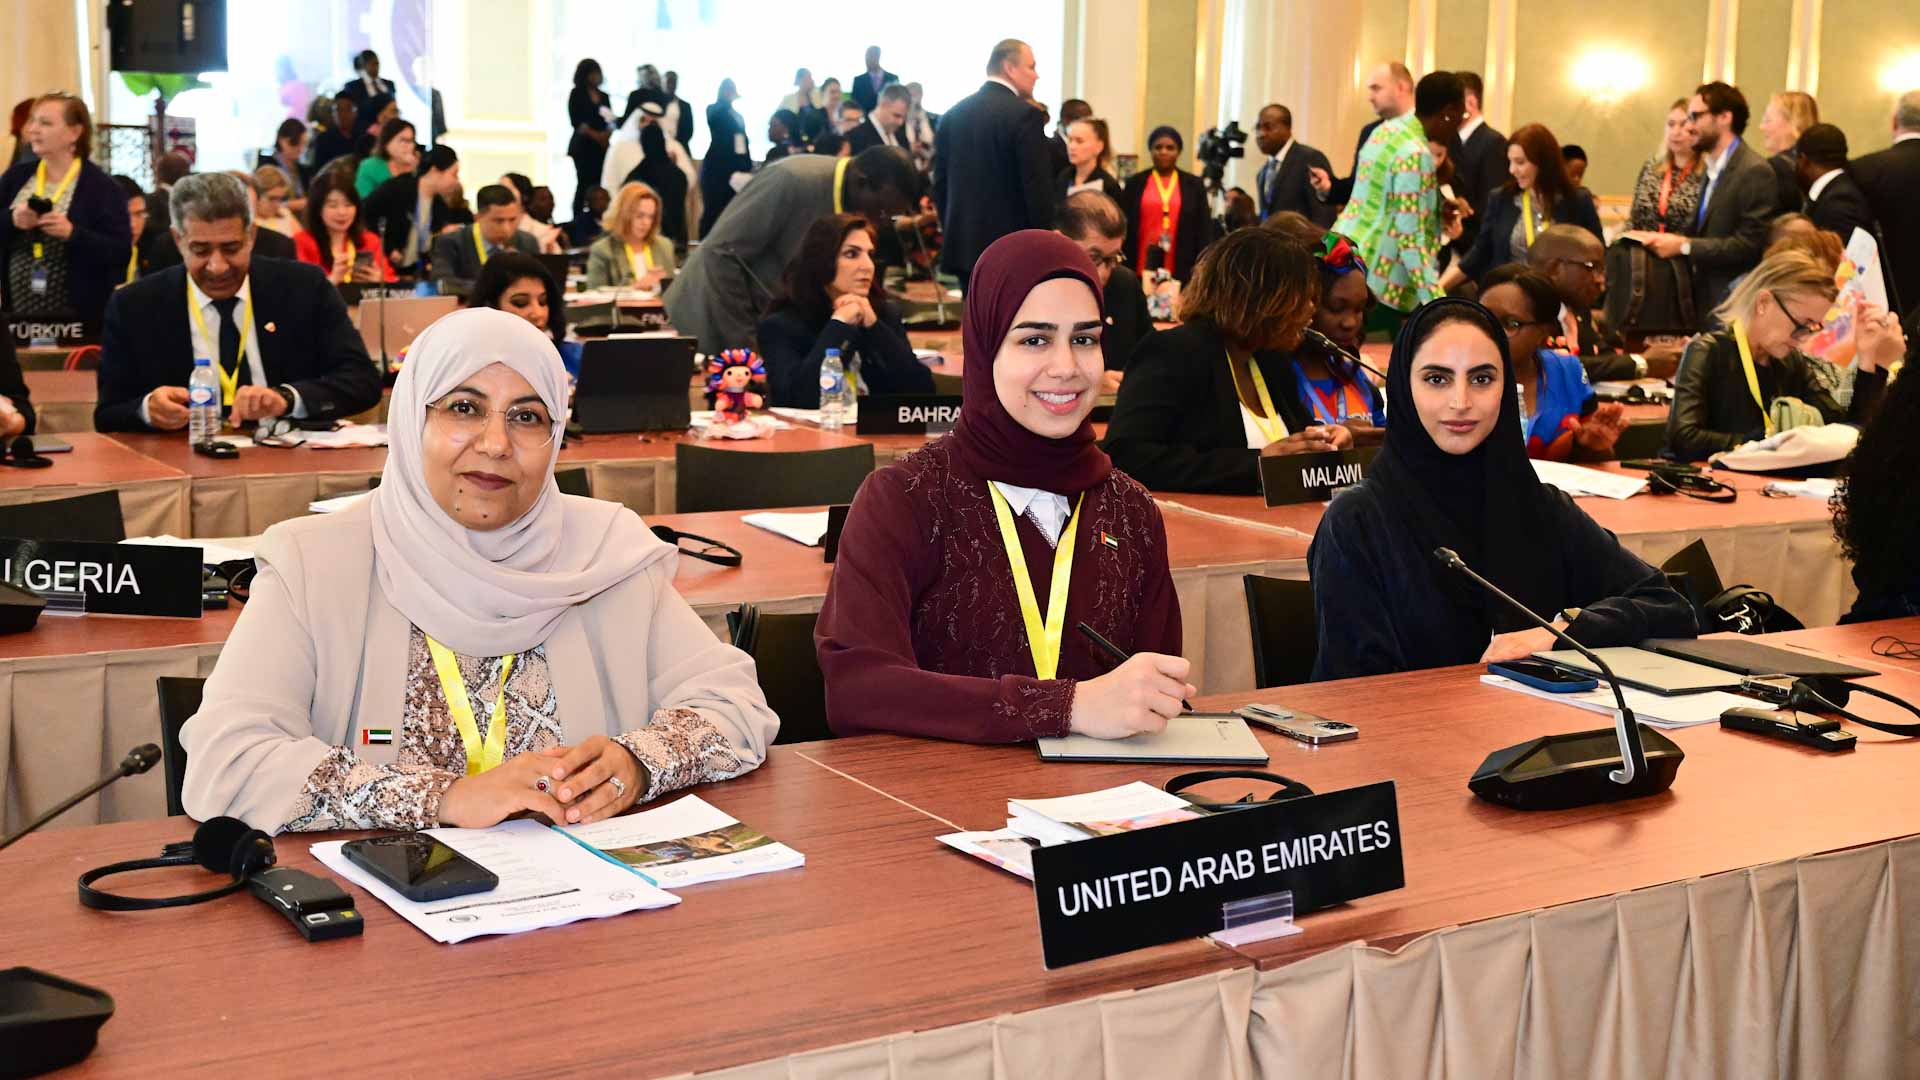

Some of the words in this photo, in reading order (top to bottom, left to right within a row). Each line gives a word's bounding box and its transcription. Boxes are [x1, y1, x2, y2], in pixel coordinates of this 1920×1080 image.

[1301, 463, 1362, 489] MALAWI
[1058, 866, 1172, 917] UNITED
[1179, 849, 1256, 892] ARAB
[1261, 820, 1391, 874] EMIRATES
